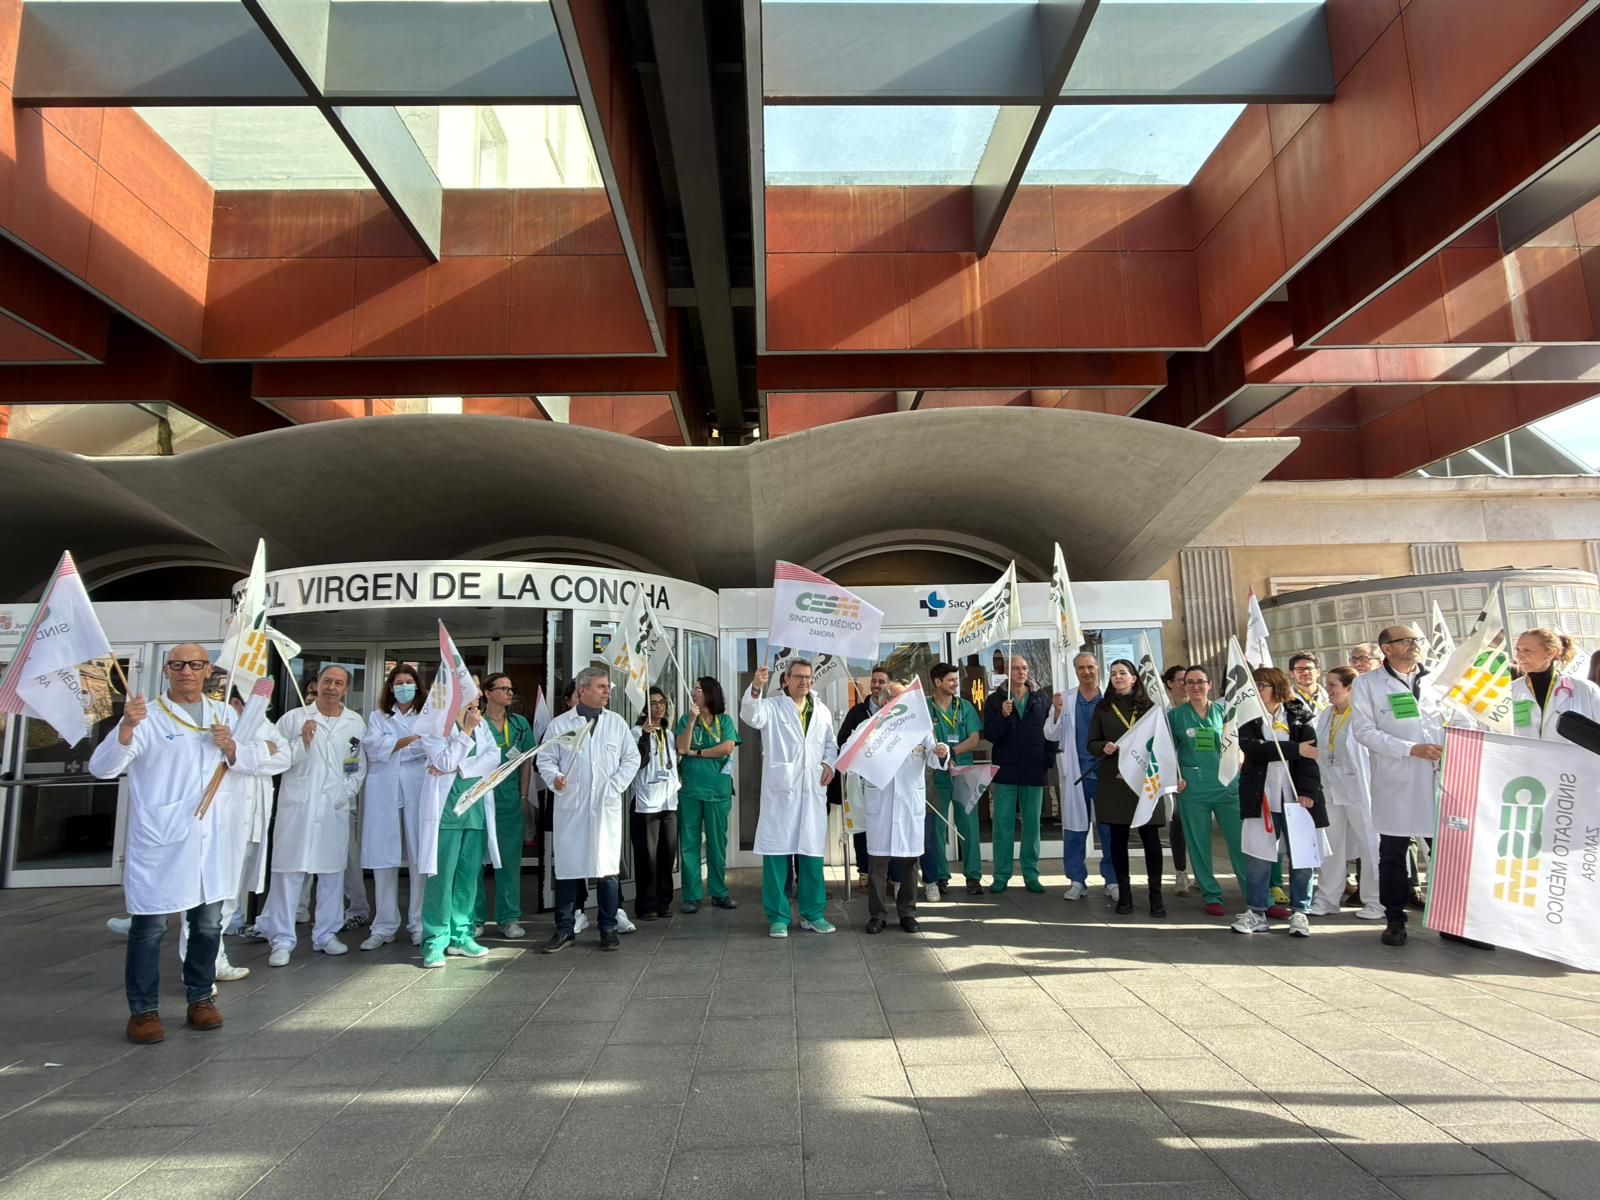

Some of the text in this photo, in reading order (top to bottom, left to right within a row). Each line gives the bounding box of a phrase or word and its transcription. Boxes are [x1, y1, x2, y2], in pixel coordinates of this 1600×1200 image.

[298, 572, 418, 605] VIRGEN
[432, 572, 481, 600] DE
[498, 573, 541, 601] LA
[550, 574, 670, 611] CONCHA
[788, 613, 863, 631] SINDICATO MÉDICO
[808, 628, 835, 639] ZAMORA
